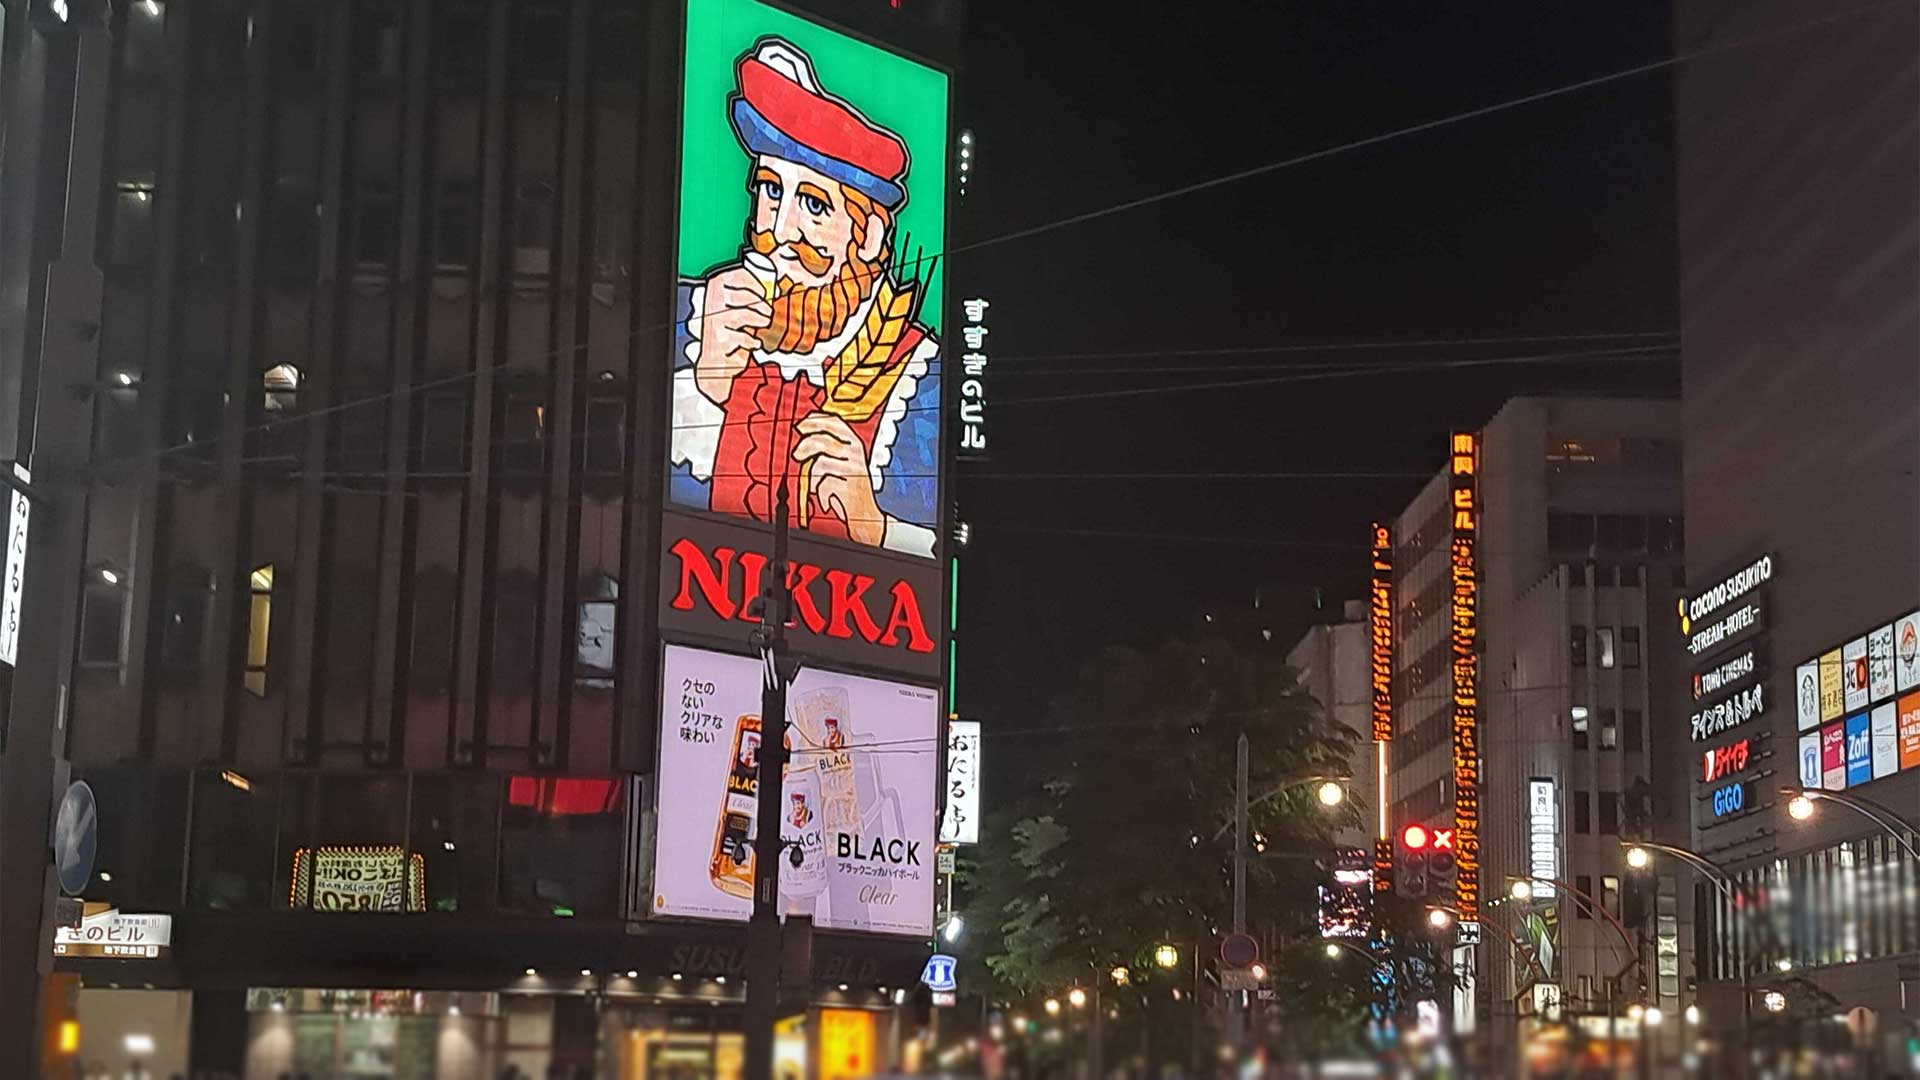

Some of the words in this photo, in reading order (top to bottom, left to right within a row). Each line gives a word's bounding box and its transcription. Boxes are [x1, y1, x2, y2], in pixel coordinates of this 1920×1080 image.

[960, 299, 990, 449] すすきのビル
[671, 538, 936, 652] NIKKA
[682, 678, 716, 696] クセの
[681, 693, 704, 710] ない
[680, 711, 723, 730] クリアな
[680, 727, 715, 744] 味わい
[1848, 728, 1869, 762] Zoff
[729, 775, 759, 793] BLAC
[837, 832, 920, 866] BLACK
[859, 884, 898, 905] Clear
